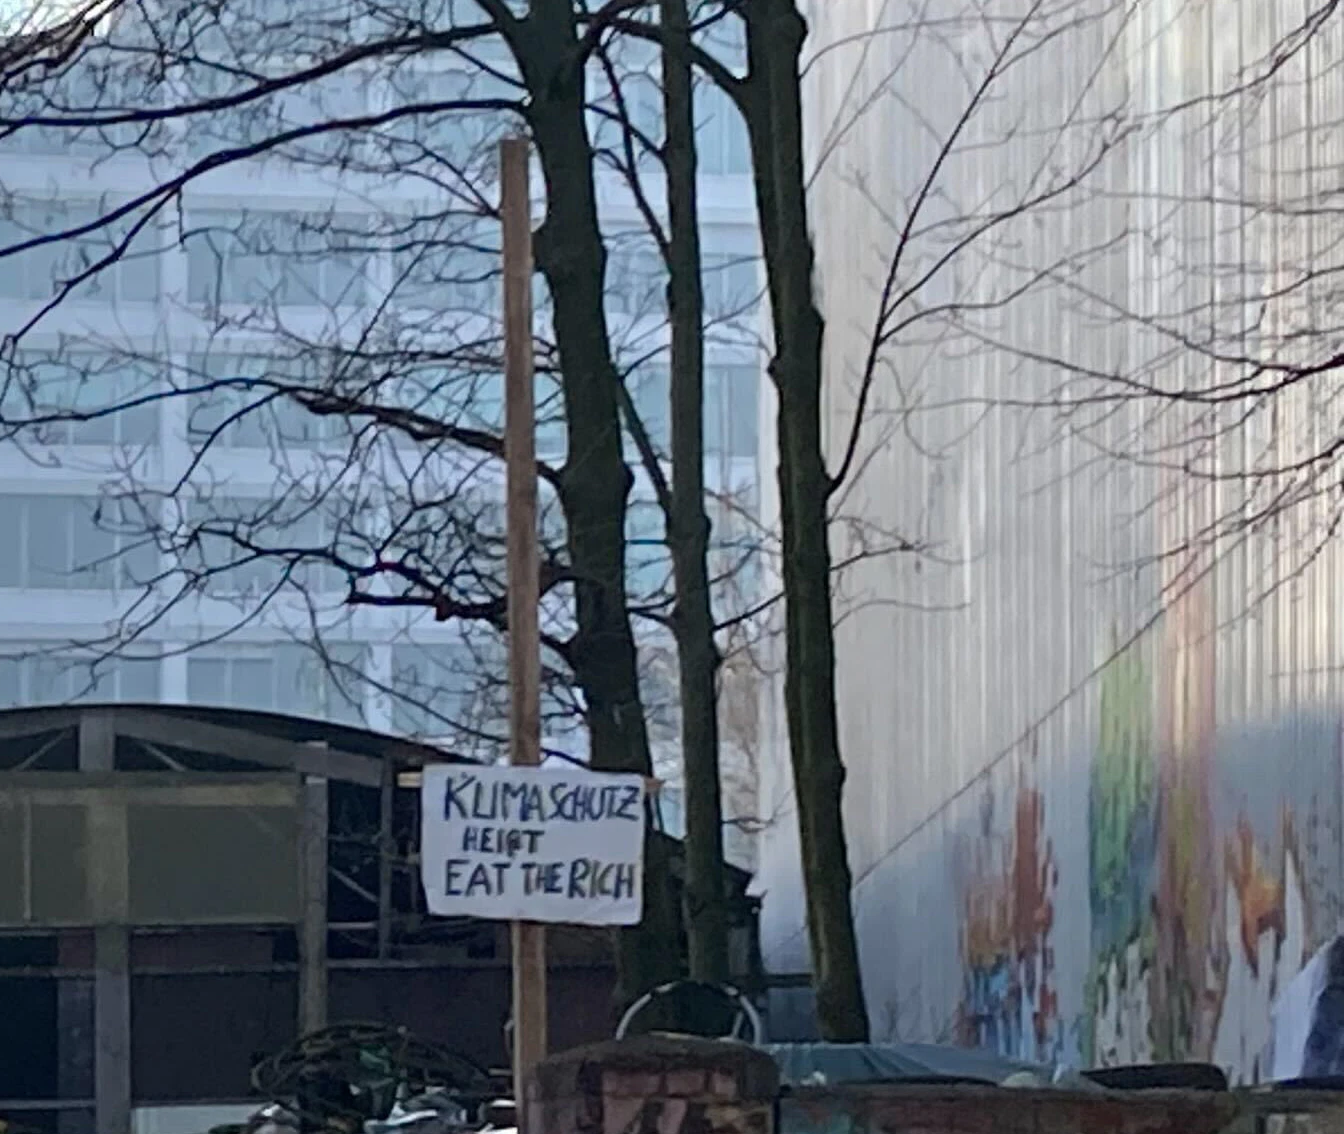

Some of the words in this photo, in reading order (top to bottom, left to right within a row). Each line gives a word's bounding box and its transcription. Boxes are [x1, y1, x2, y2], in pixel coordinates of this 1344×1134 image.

[443, 774, 641, 823] KLIMASCHUTZ
[444, 858, 511, 897] EAT
[520, 860, 565, 896] THE
[567, 857, 635, 899] RICH
